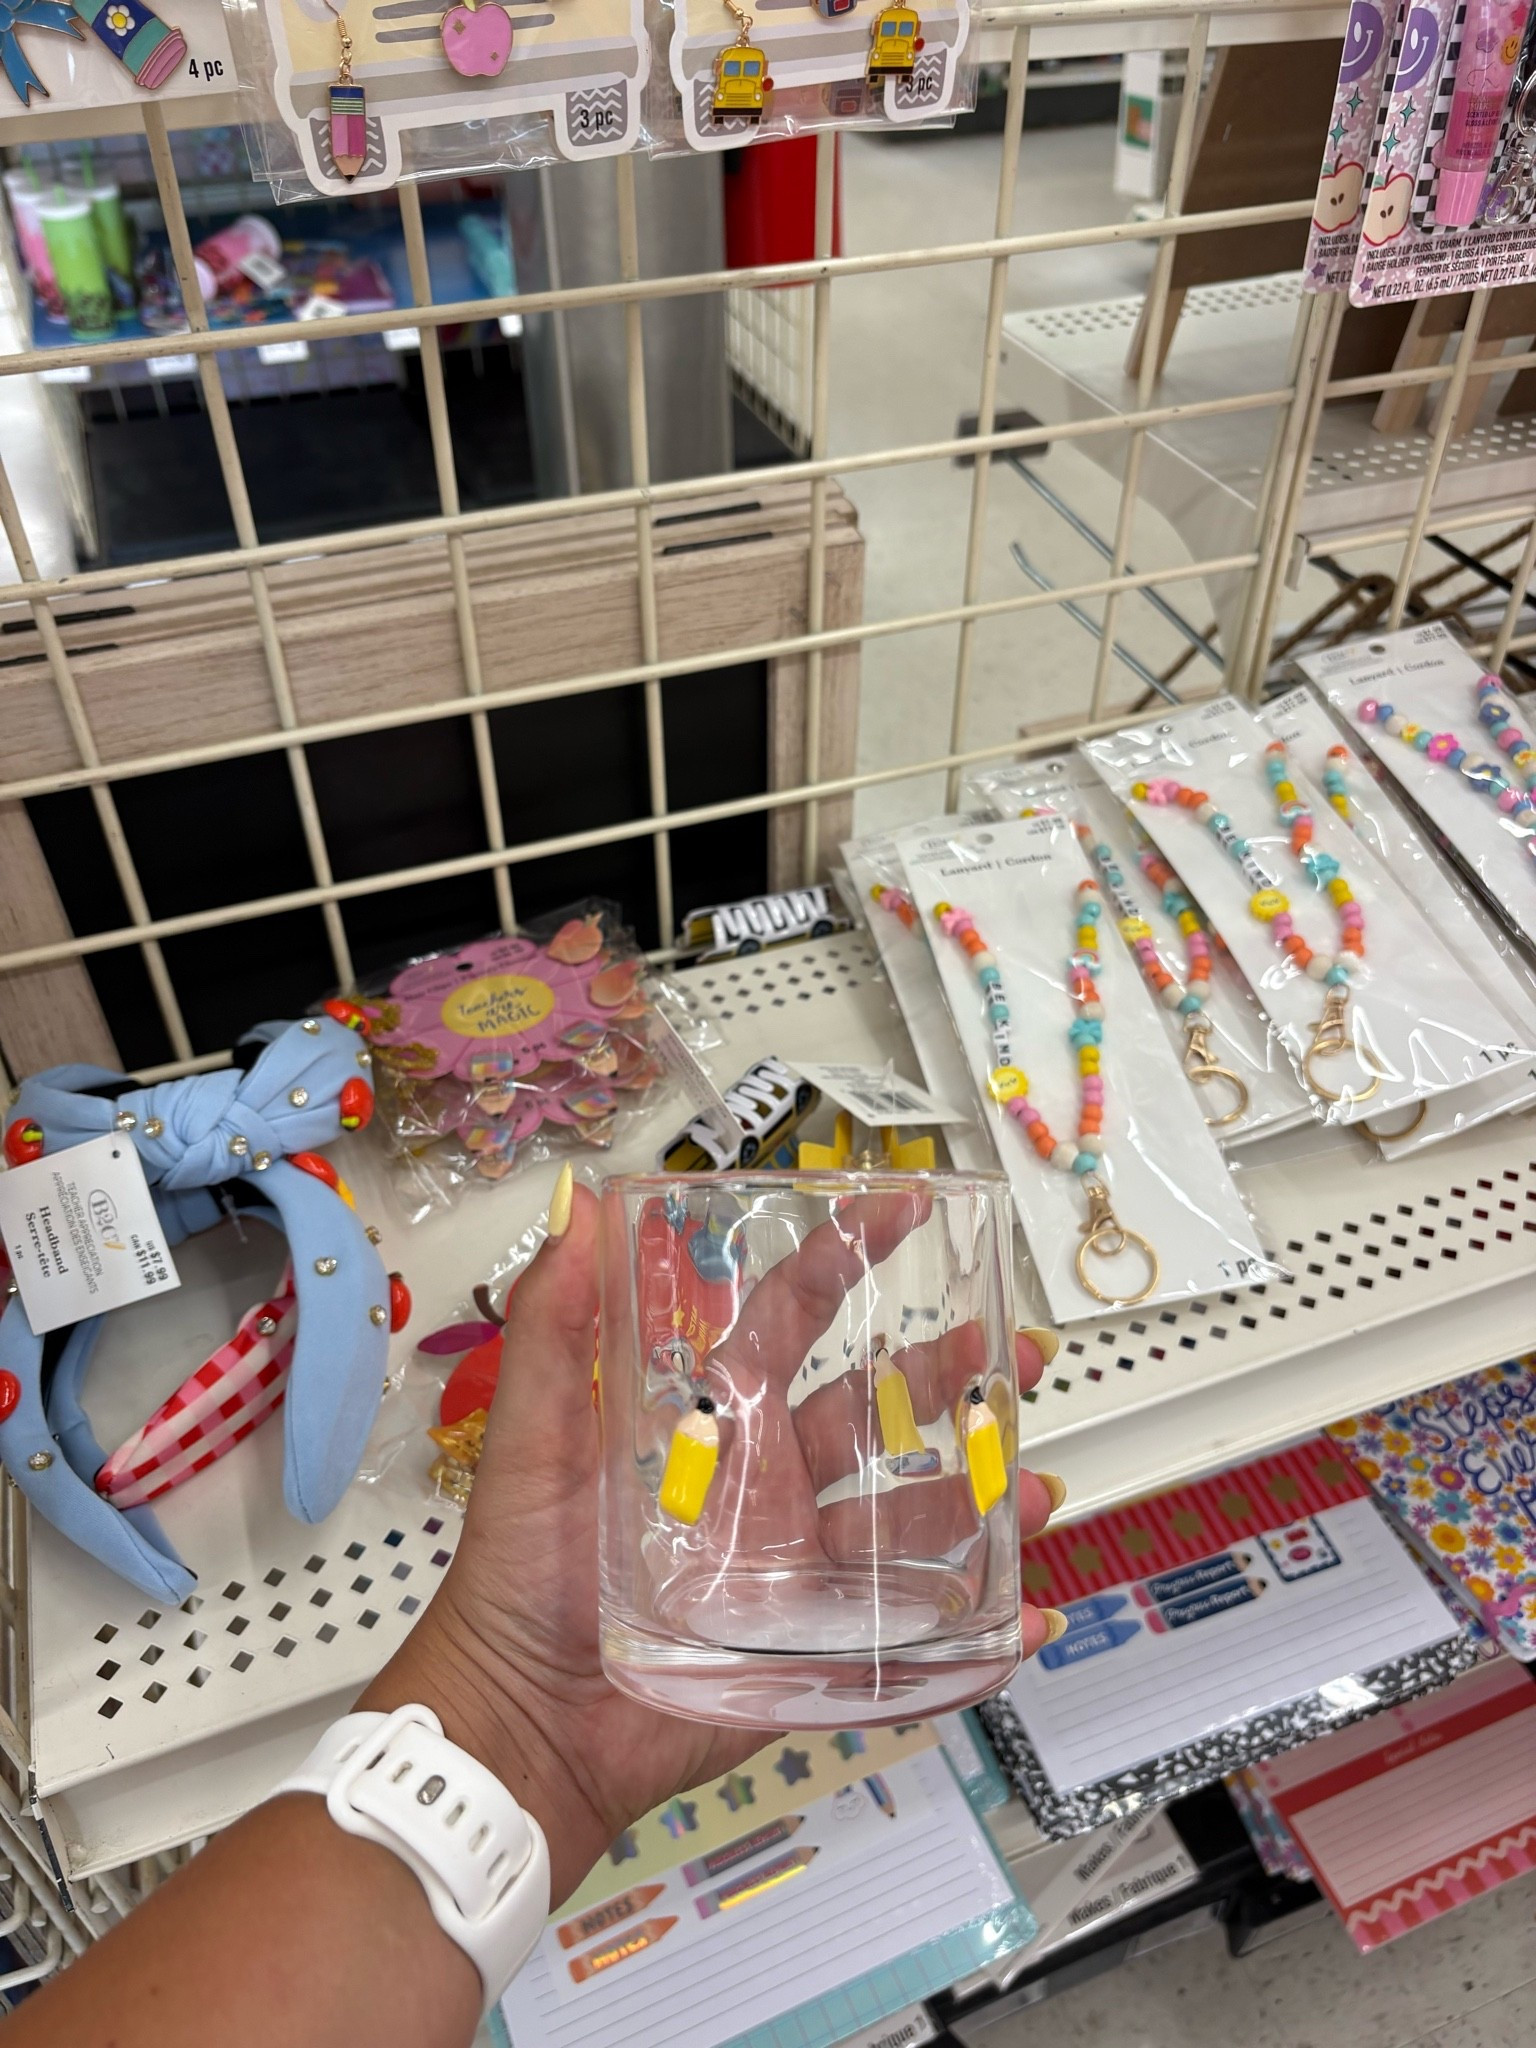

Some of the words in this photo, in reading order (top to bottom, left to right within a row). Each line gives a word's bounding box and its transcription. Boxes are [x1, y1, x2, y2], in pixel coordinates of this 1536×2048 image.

[188, 58, 200, 79] 4
[204, 58, 224, 82] pc
[915, 74, 933, 96] pc
[580, 109, 590, 128] 3
[593, 109, 614, 134] pc
[1372, 283, 1386, 299] NET
[1479, 269, 1494, 283] NET
[940, 862, 993, 878] Lanyard
[1005, 853, 1053, 868] Cordon
[476, 1004, 542, 1034] MAGIC
[66, 1182, 86, 1221] TEACHER
[25, 1211, 52, 1279] Serre-tête
[39, 1206, 70, 1275] Headband
[136, 1249, 157, 1286] $11.99
[150, 1250, 169, 1282] $7.99
[1118, 1861, 1178, 1900] Fabrique
[581, 1897, 634, 1936] NOTES
